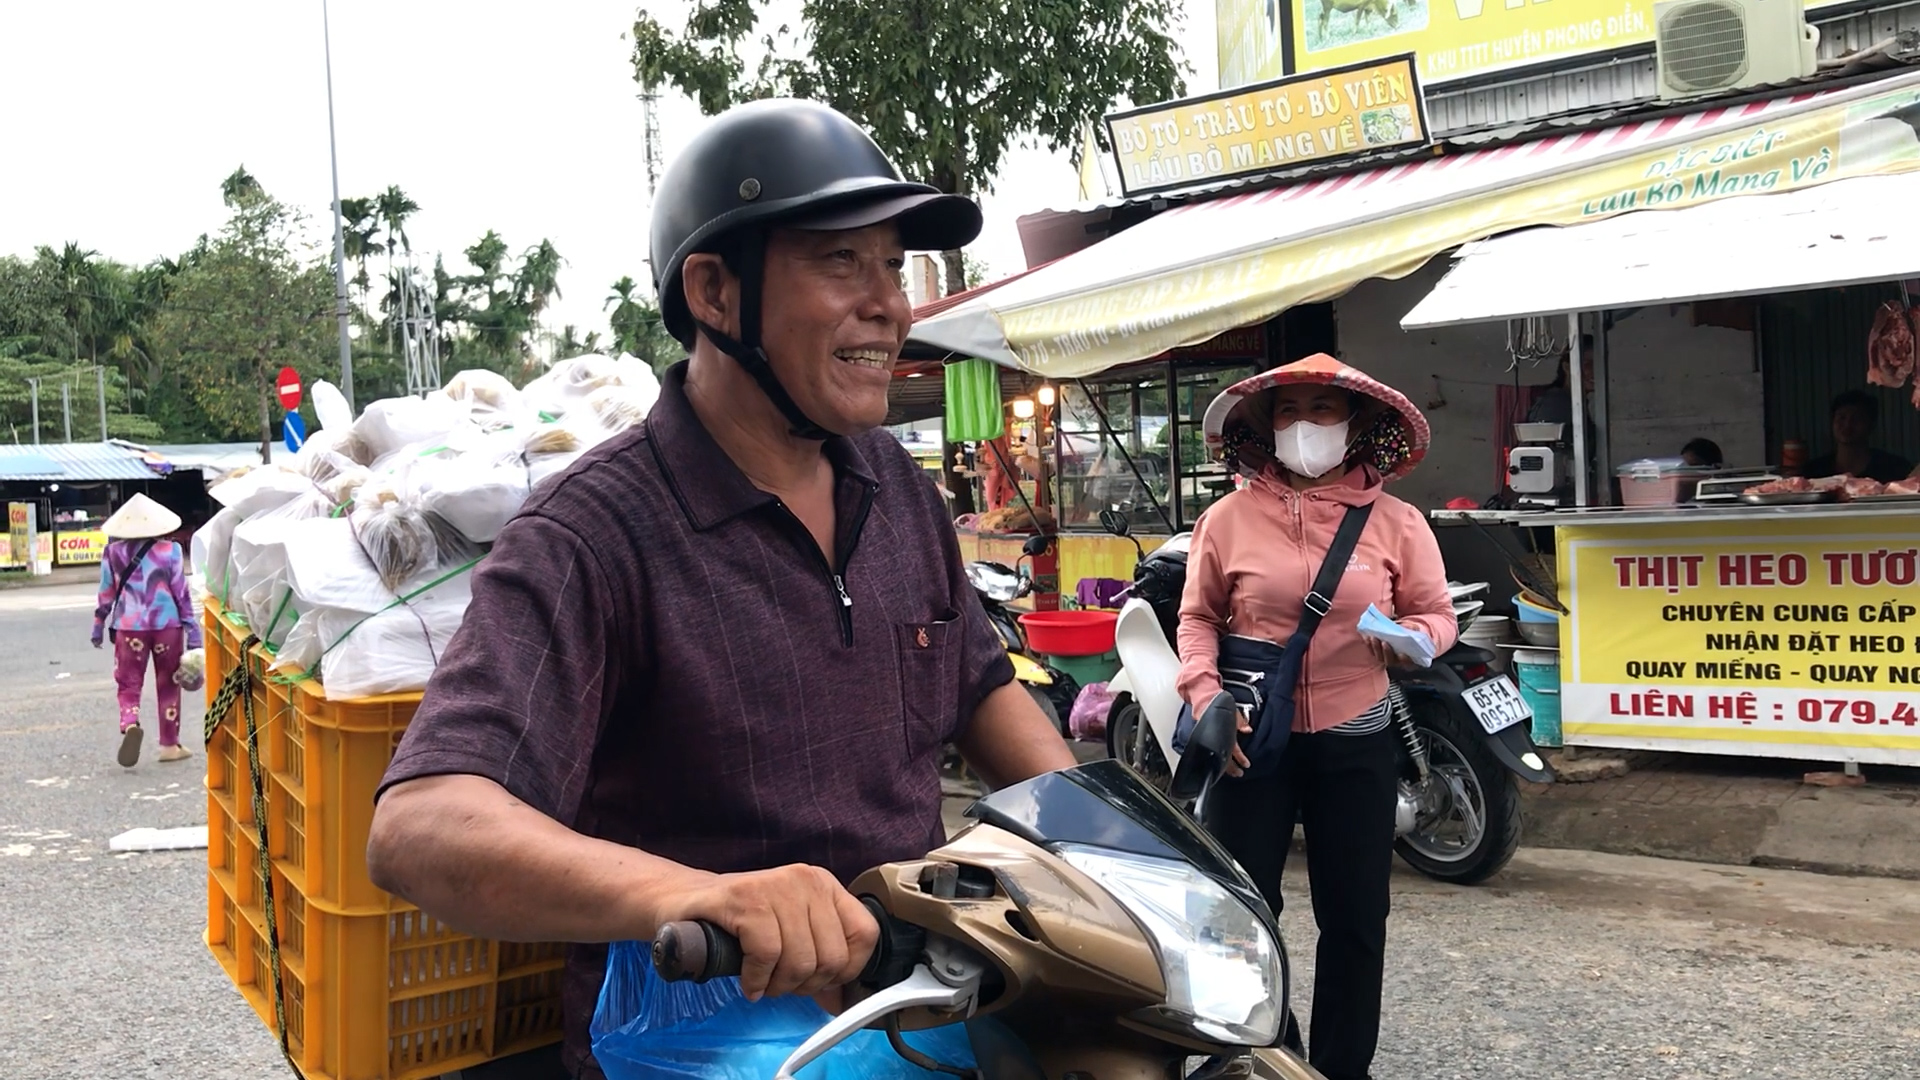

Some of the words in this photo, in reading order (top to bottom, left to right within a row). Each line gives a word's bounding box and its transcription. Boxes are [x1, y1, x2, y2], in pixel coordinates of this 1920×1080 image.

[1427, 48, 1457, 74] KHU
[1459, 41, 1489, 68] TTTT
[1544, 18, 1604, 49] PHONG
[1118, 120, 1148, 155] BÒ
[1193, 101, 1257, 140] TRÂU
[1260, 91, 1293, 127] TƠ
[1307, 80, 1341, 119] BÒ
[1344, 70, 1408, 110] VIÊN
[1187, 143, 1224, 177] BÒ
[1231, 131, 1316, 170] MANG
[1320, 116, 1358, 152] VỀ
[1691, 169, 1782, 199] Mang
[1790, 147, 1832, 183] Về
[60, 537, 90, 550] CƠM
[1613, 555, 1704, 593] THỊT
[1719, 554, 1807, 587] HEO
[1662, 601, 1764, 622] CHUYÊN
[1774, 604, 1848, 622] CUNG
[1859, 599, 1917, 623] CẤP
[1706, 631, 1779, 654] NHẬN
[1789, 631, 1840, 655] ĐẶT
[1850, 636, 1905, 654] HEO
[1626, 660, 1687, 679] QUAY
[1696, 657, 1780, 680] MIẾNG
[1810, 664, 1879, 684] QUAY
[1480, 697, 1526, 730] 095.77
[1610, 689, 1694, 718] LIÊN
[1708, 691, 1758, 725] HỆ
